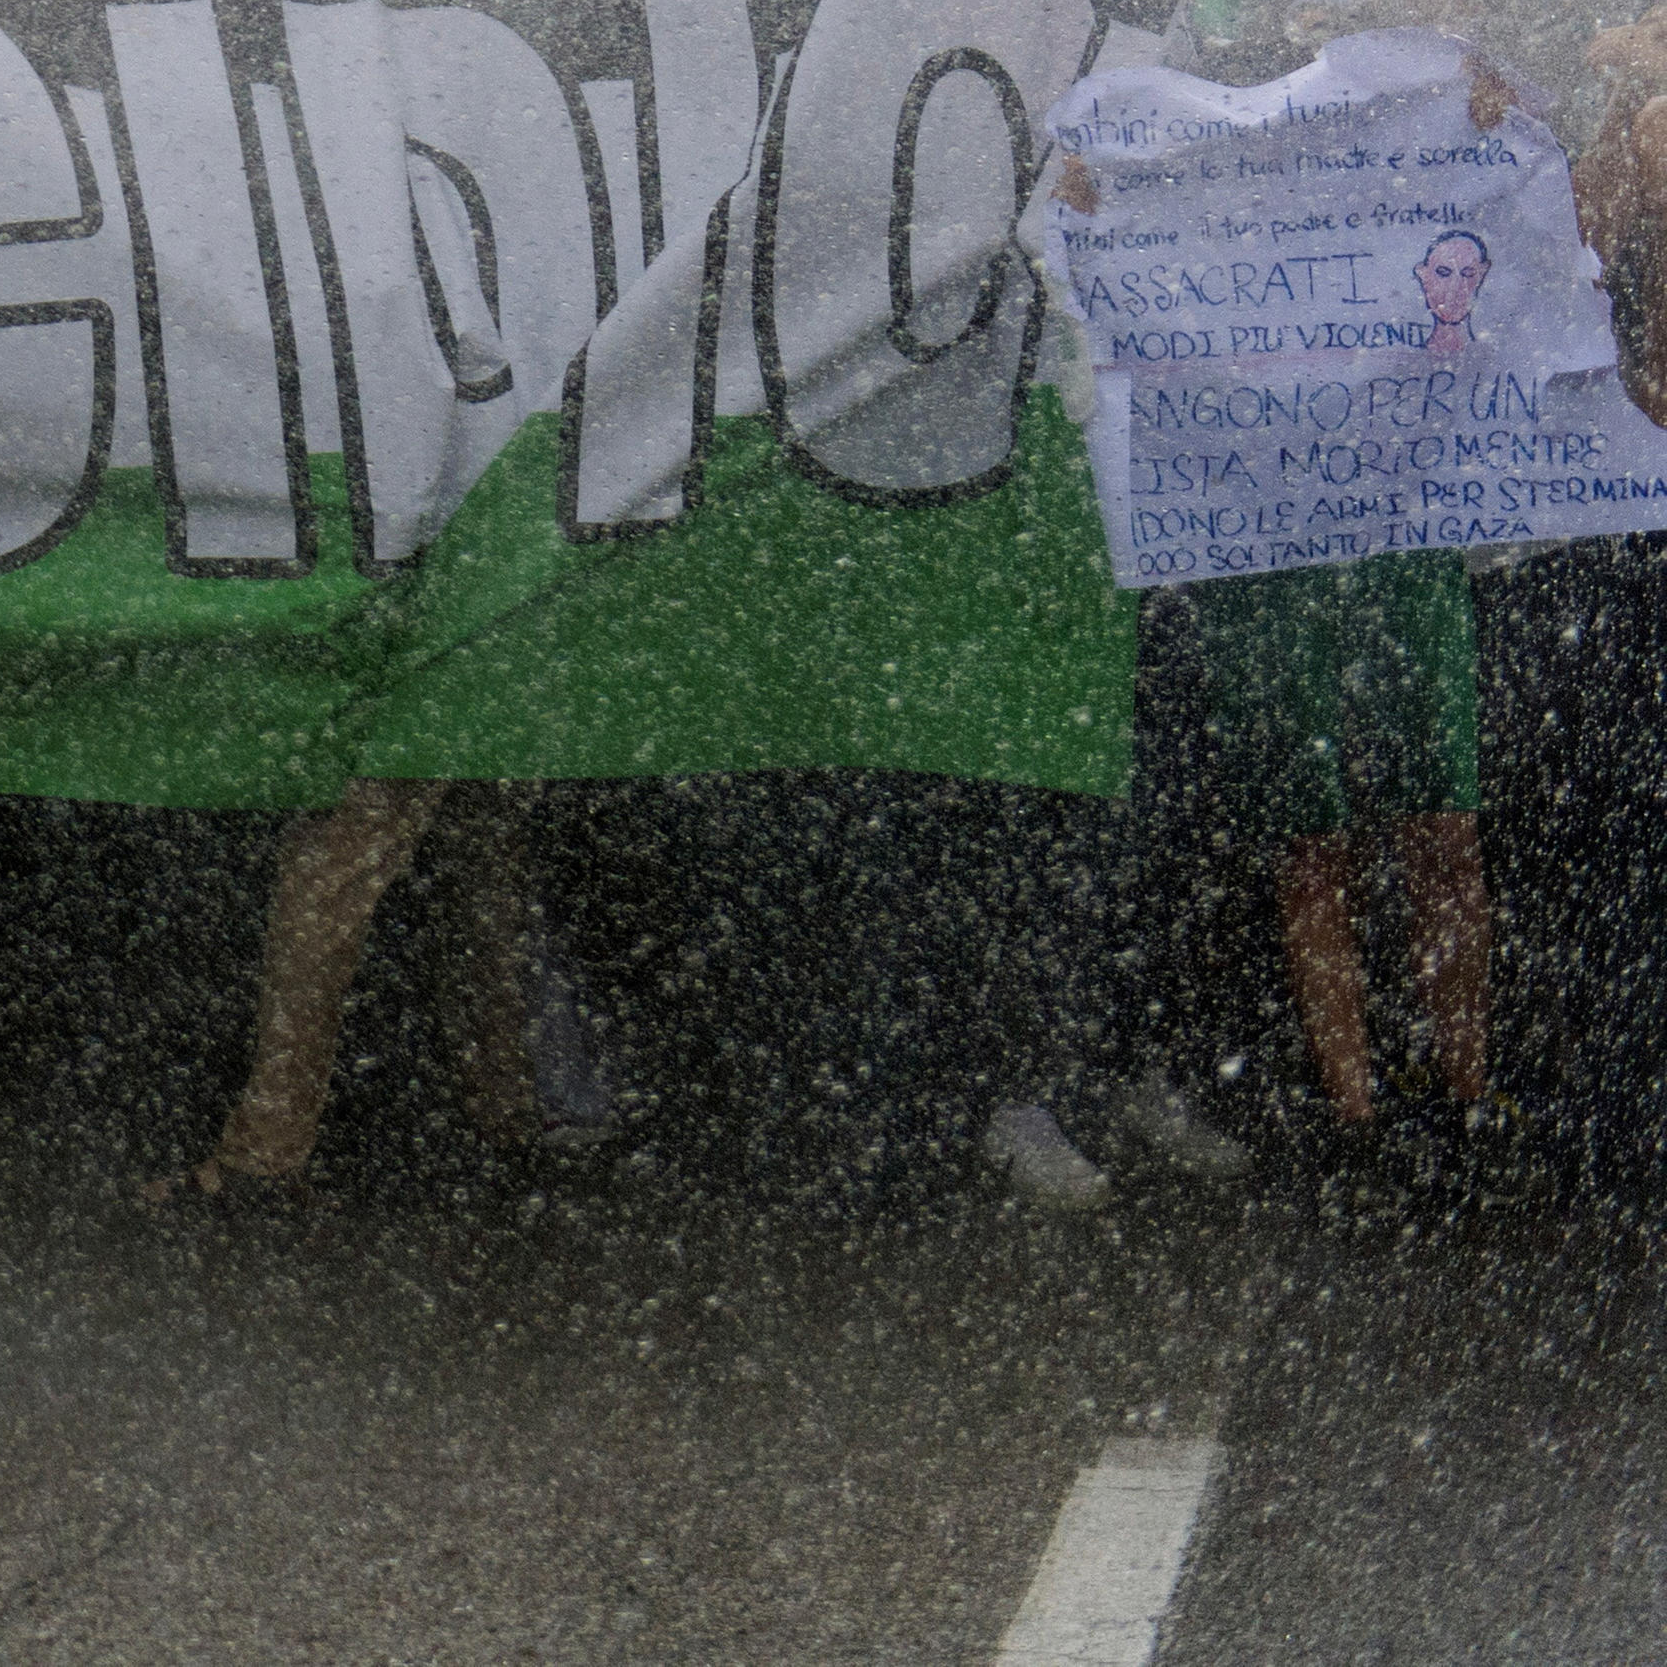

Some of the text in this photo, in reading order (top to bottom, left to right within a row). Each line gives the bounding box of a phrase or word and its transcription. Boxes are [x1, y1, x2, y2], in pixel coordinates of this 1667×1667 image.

[1418, 134, 1518, 168] sorella
[1112, 330, 1221, 361] MODI
[1366, 370, 1452, 428] PER
[1469, 371, 1539, 424] UN
[1454, 430, 1610, 471] MENTRE
[1131, 507, 1247, 548] DONO
[1256, 501, 1295, 535] LE
[1307, 492, 1407, 524] ARMI
[1421, 479, 1486, 510] PER
[1384, 519, 1428, 547] IN
[1438, 516, 1535, 543] GAZA
